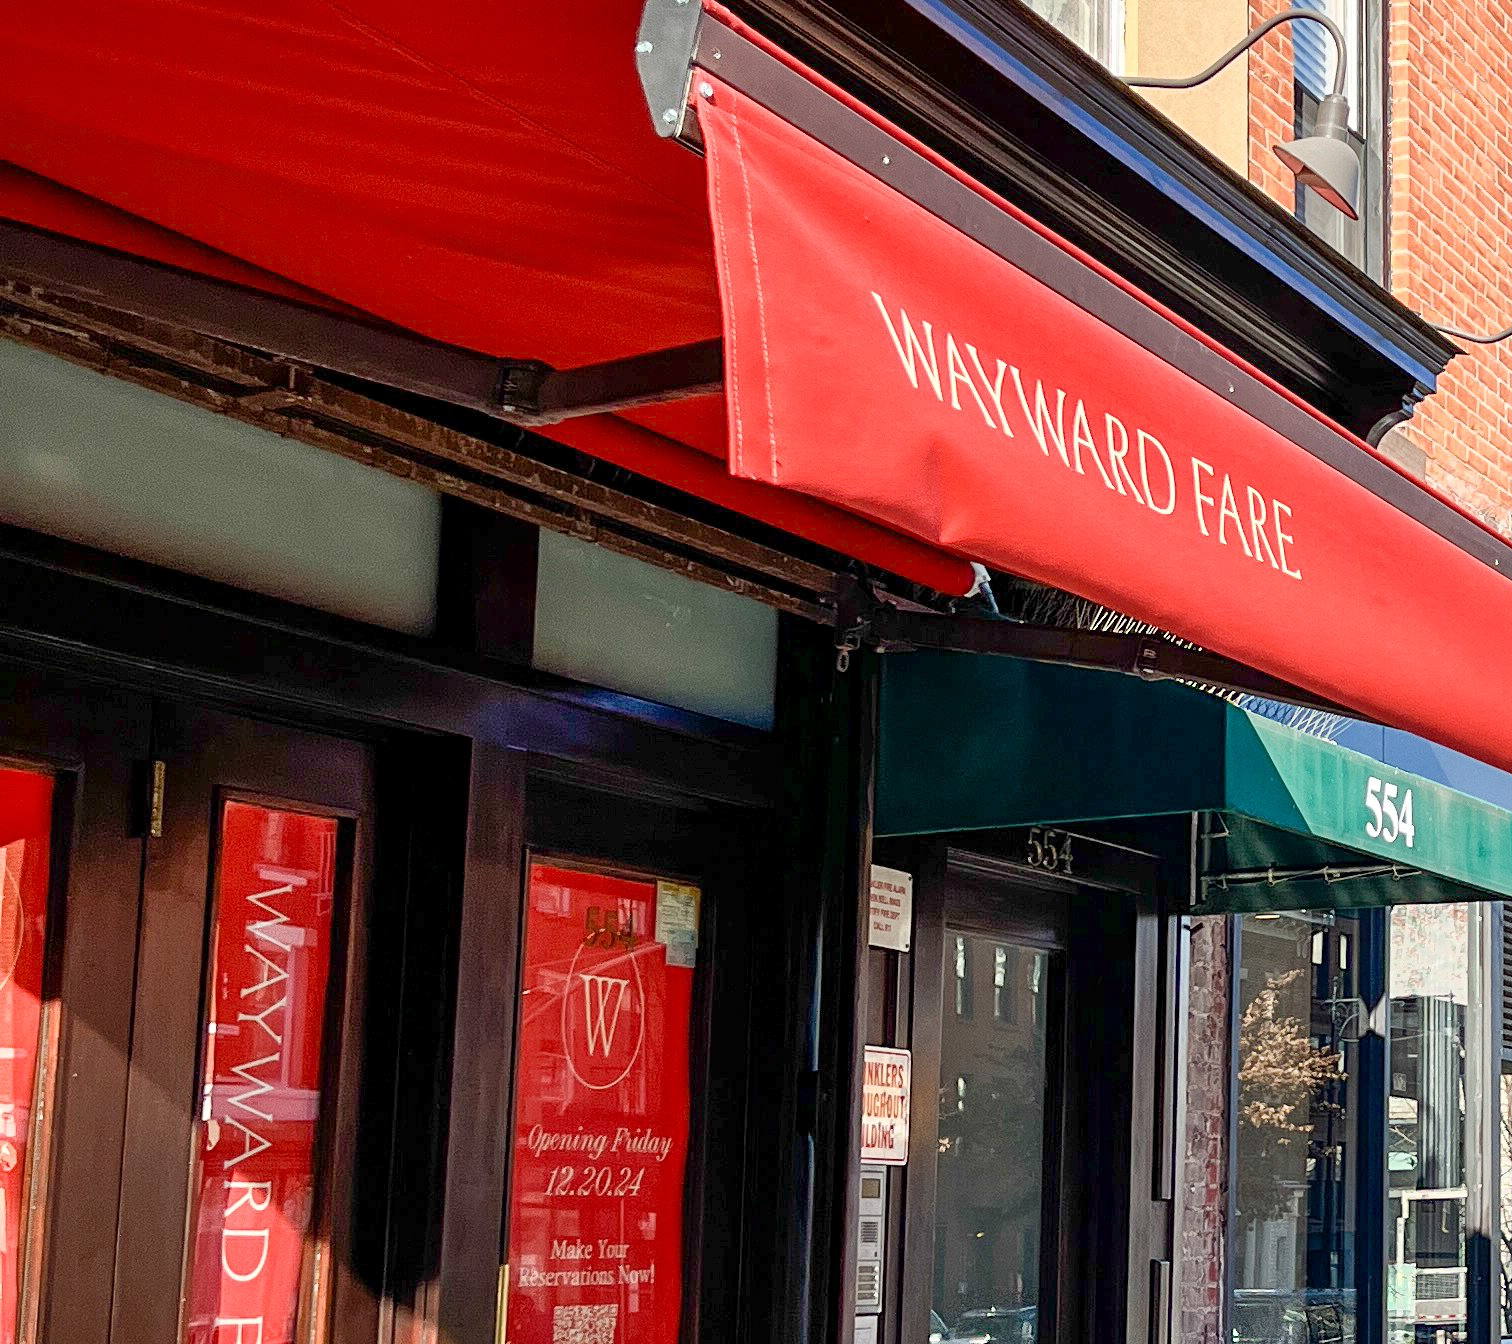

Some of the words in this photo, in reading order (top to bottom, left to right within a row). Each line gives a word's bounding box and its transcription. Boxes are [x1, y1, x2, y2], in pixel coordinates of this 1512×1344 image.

[871, 291, 1177, 516] WAYWARD
[1191, 456, 1302, 580] FARE
[1365, 776, 1415, 848] 554
[1027, 827, 1074, 874] 554
[585, 907, 636, 954] 554
[578, 973, 630, 1058] W
[221, 883, 294, 1282] WAYWARD
[527, 1123, 609, 1161] Opening
[611, 1127, 673, 1162] Friday
[544, 1165, 646, 1197] 12.20.24
[550, 1239, 593, 1260] Make
[598, 1239, 630, 1260] Your
[518, 1266, 615, 1288] Reservations
[618, 1263, 656, 1285] Now!
